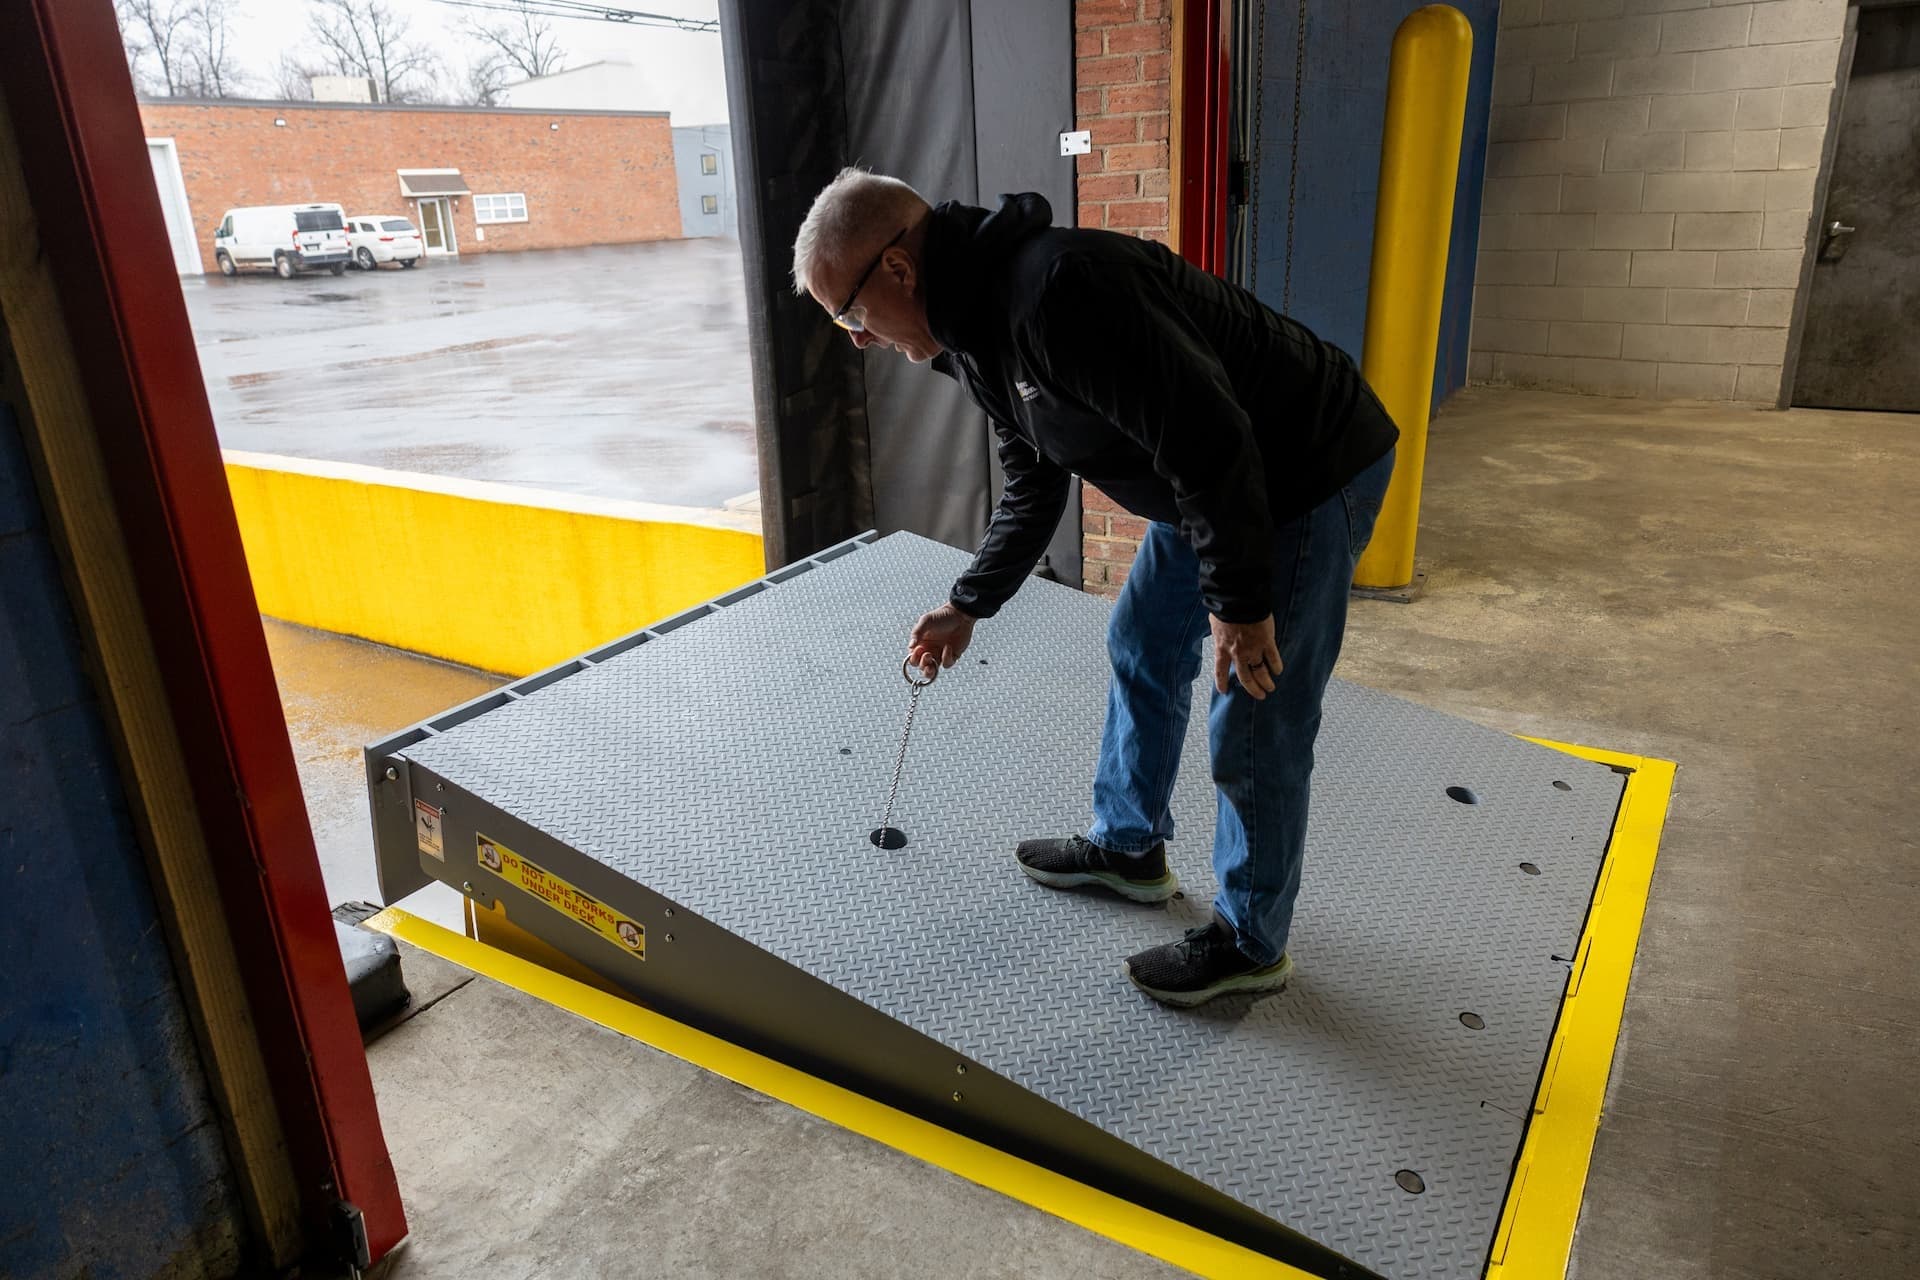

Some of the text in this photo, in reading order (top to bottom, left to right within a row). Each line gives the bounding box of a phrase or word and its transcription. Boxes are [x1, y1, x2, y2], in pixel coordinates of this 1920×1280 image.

[503, 854, 615, 924] DO NOT USE FORKS
[521, 875, 596, 924] UNDER DECK
